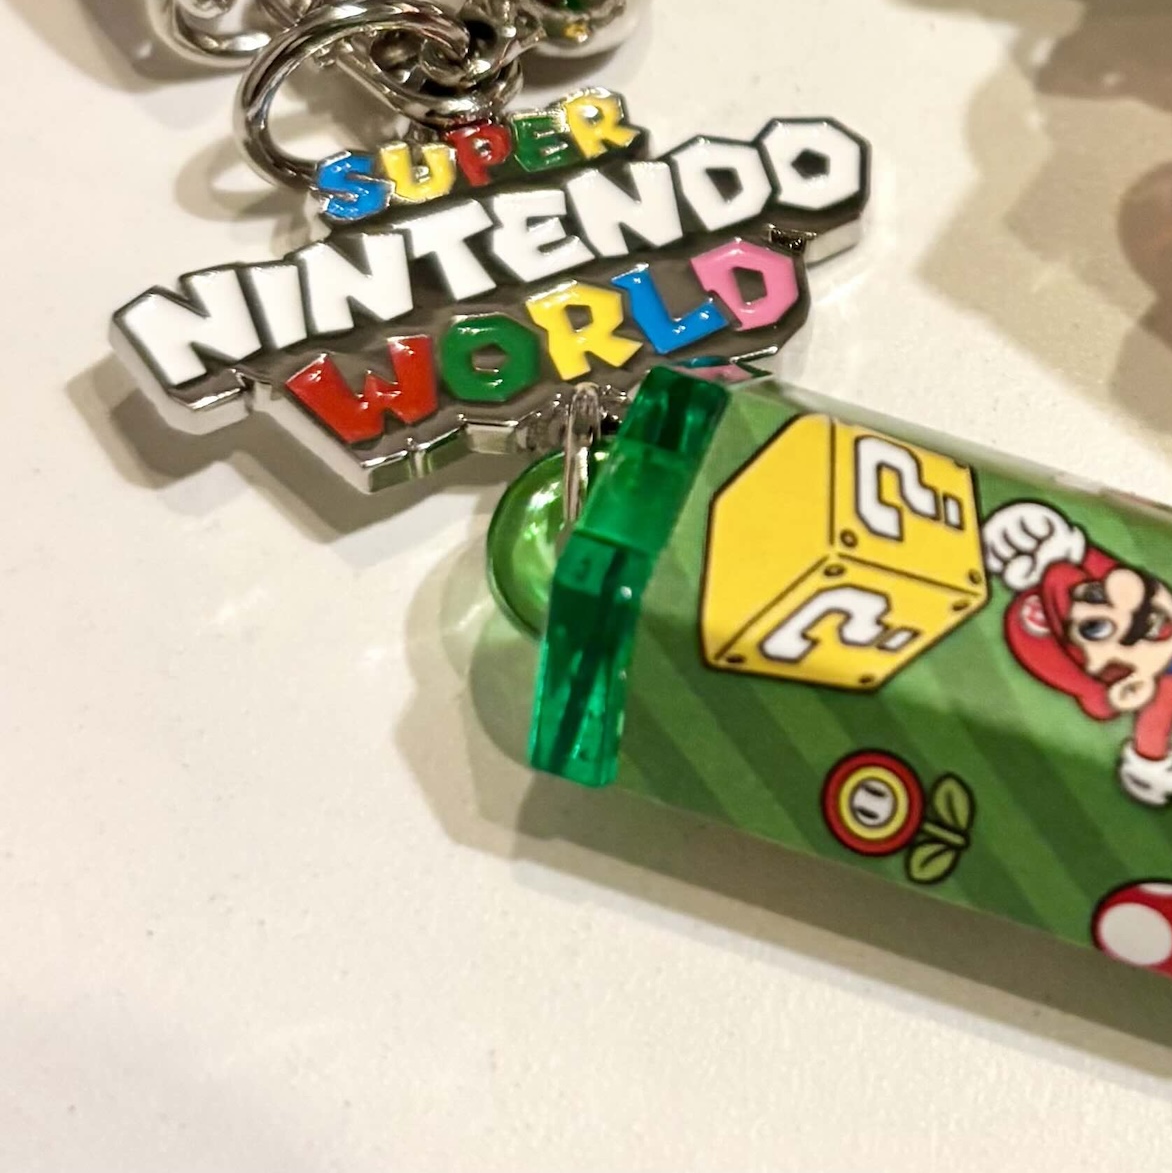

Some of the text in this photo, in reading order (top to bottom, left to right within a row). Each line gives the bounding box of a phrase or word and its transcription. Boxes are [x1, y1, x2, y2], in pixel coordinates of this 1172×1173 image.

[120, 118, 870, 387] NINTENDO
[314, 87, 642, 221] SUPER
[284, 237, 800, 444] WORLD
